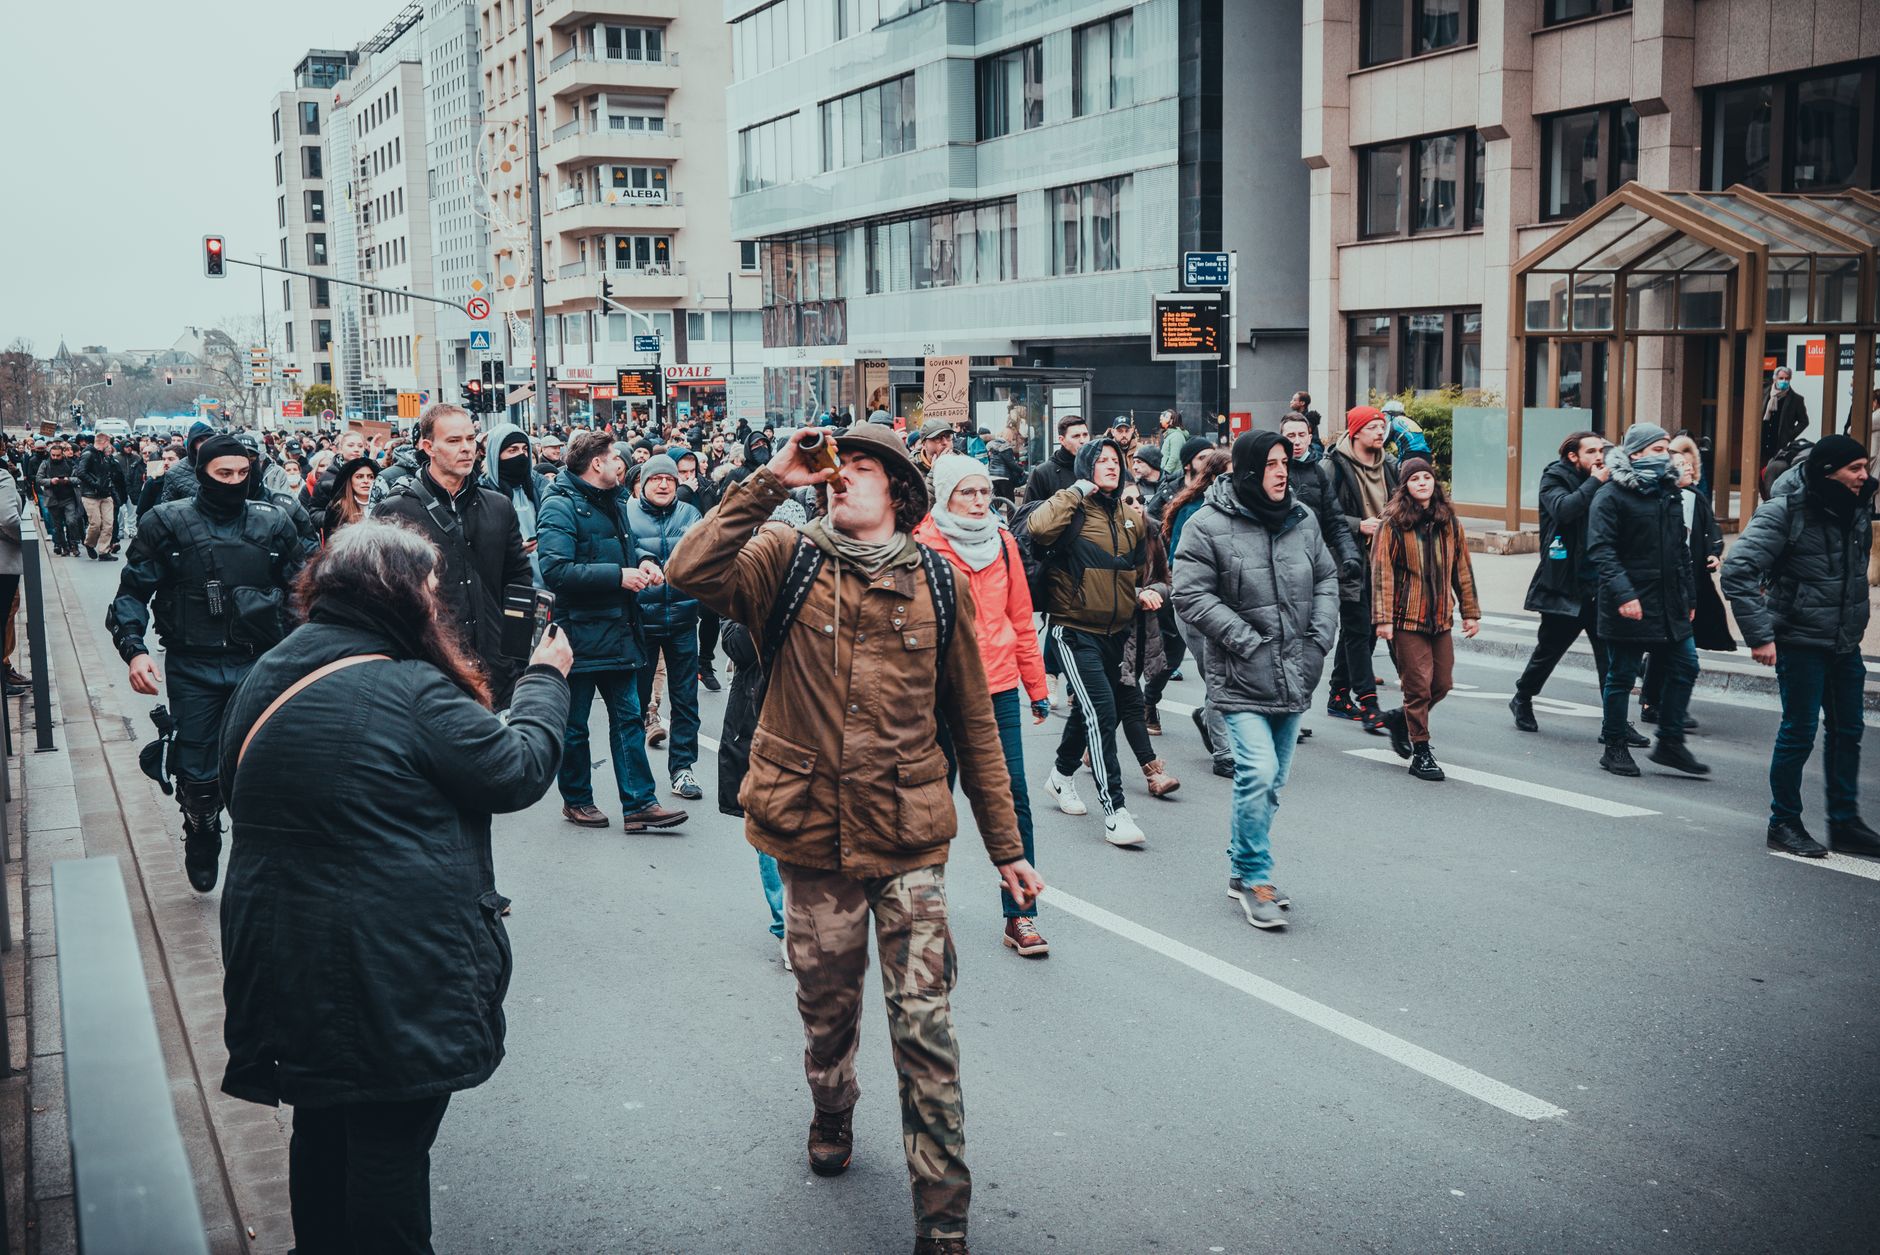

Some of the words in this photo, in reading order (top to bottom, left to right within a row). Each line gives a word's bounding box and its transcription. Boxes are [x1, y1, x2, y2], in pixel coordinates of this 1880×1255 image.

[623, 189, 661, 198] ALEBA
[923, 344, 936, 355] 26A
[1808, 345, 1826, 355] lalu
[929, 359, 953, 367] GOVERN
[954, 358, 964, 366] ME
[667, 367, 712, 378] OYALE
[924, 410, 947, 419] HARDER
[948, 409, 968, 417] DADDY
